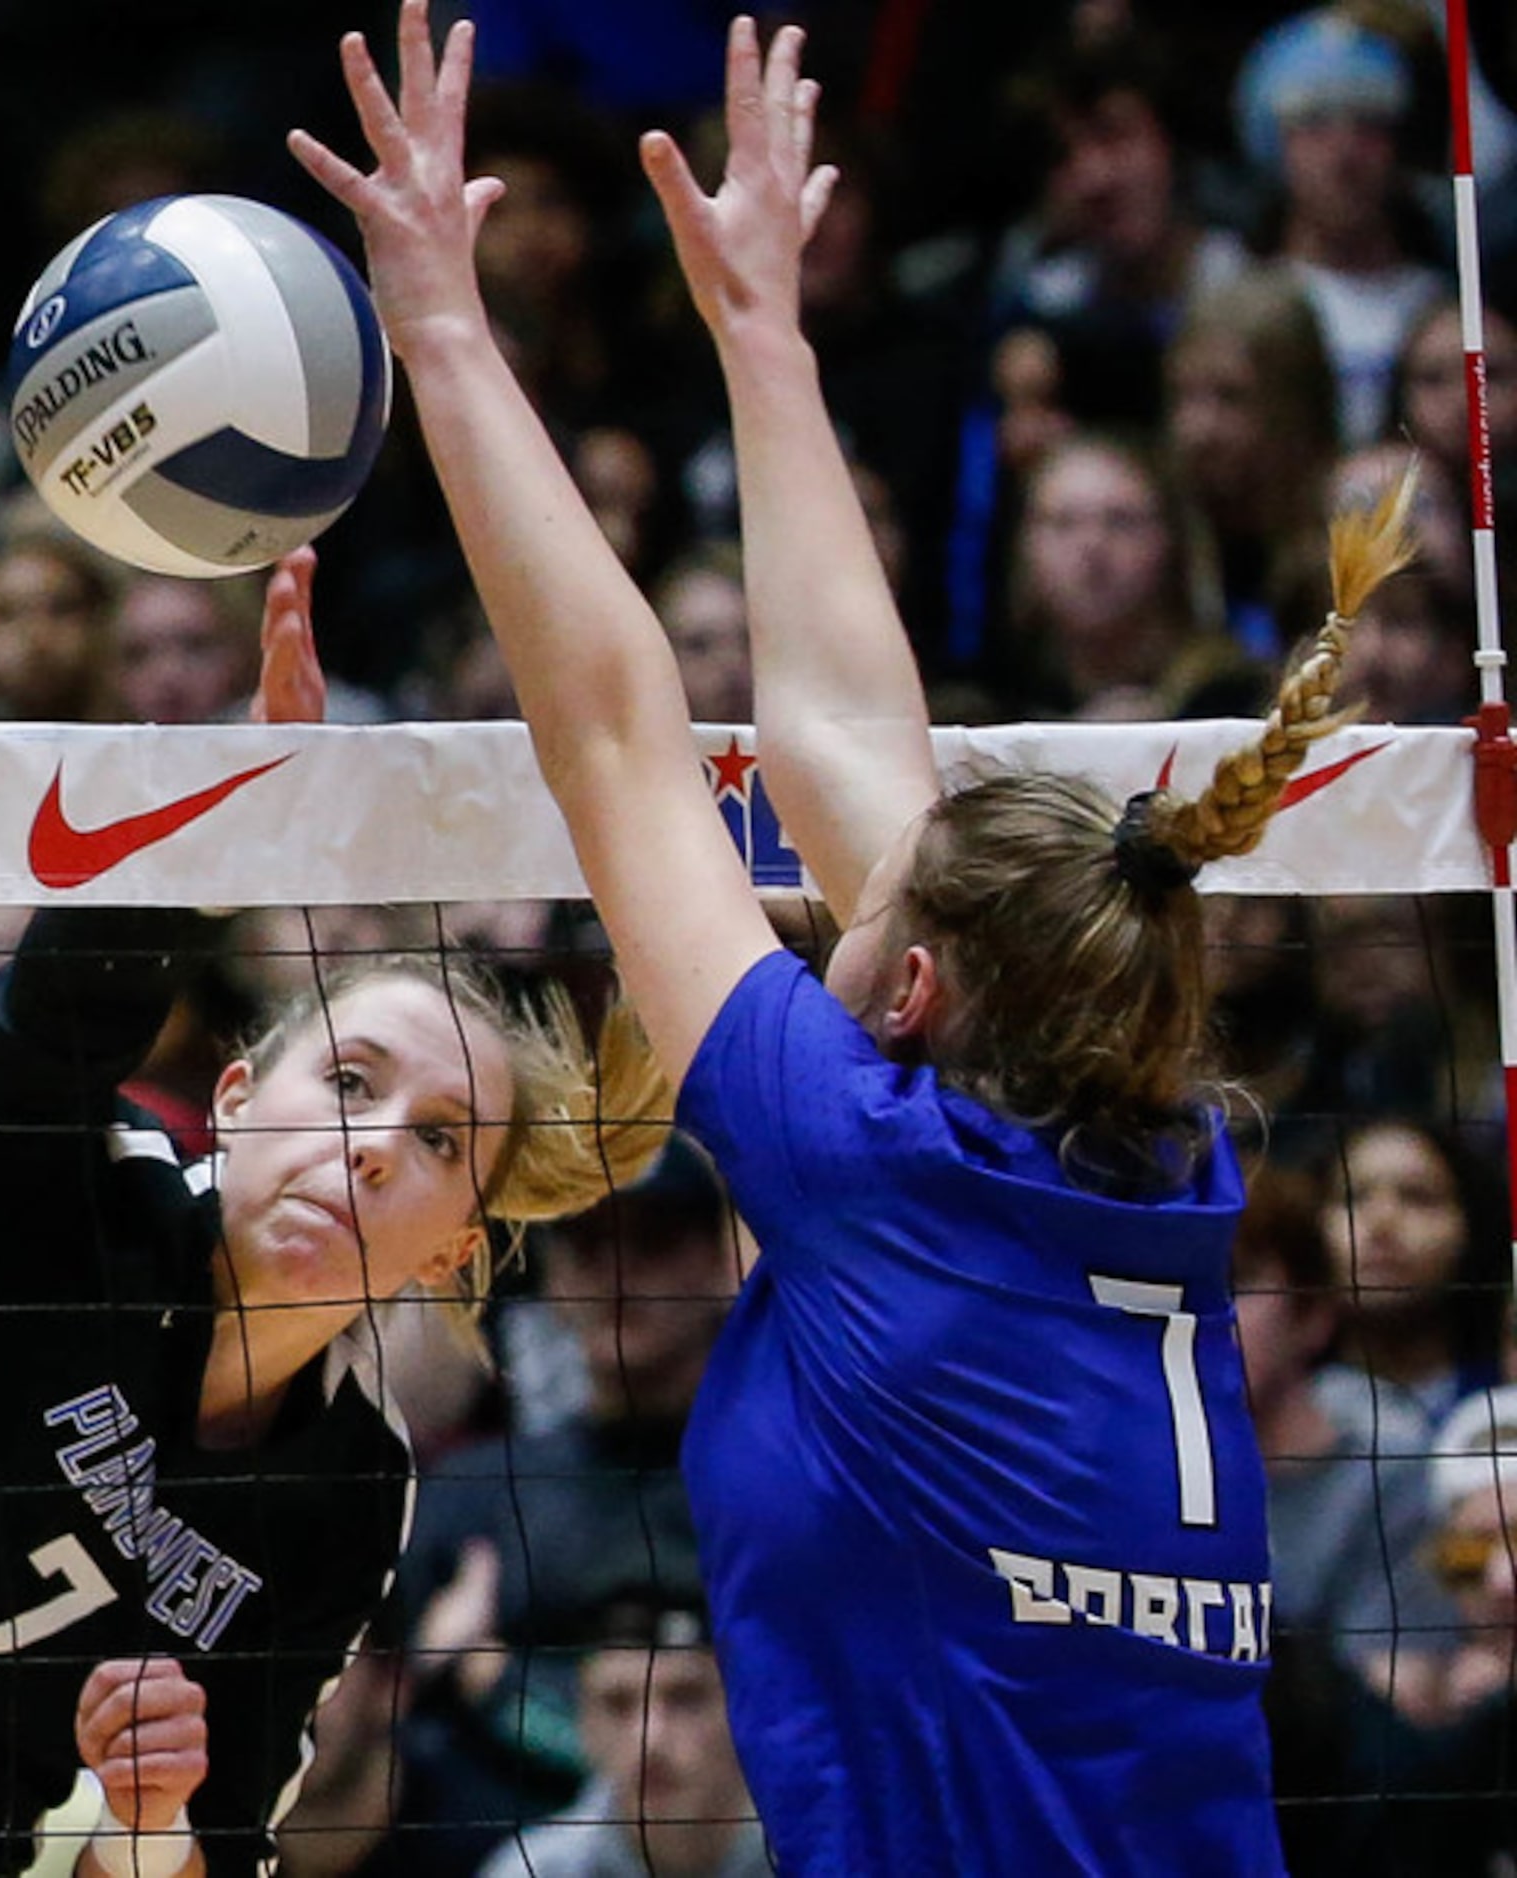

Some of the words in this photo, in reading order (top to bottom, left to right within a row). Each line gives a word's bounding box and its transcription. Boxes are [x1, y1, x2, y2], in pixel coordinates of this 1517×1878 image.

[15, 321, 148, 460] SPALDING
[60, 402, 157, 496] TF-VB5
[1088, 1274, 1216, 1525] 7
